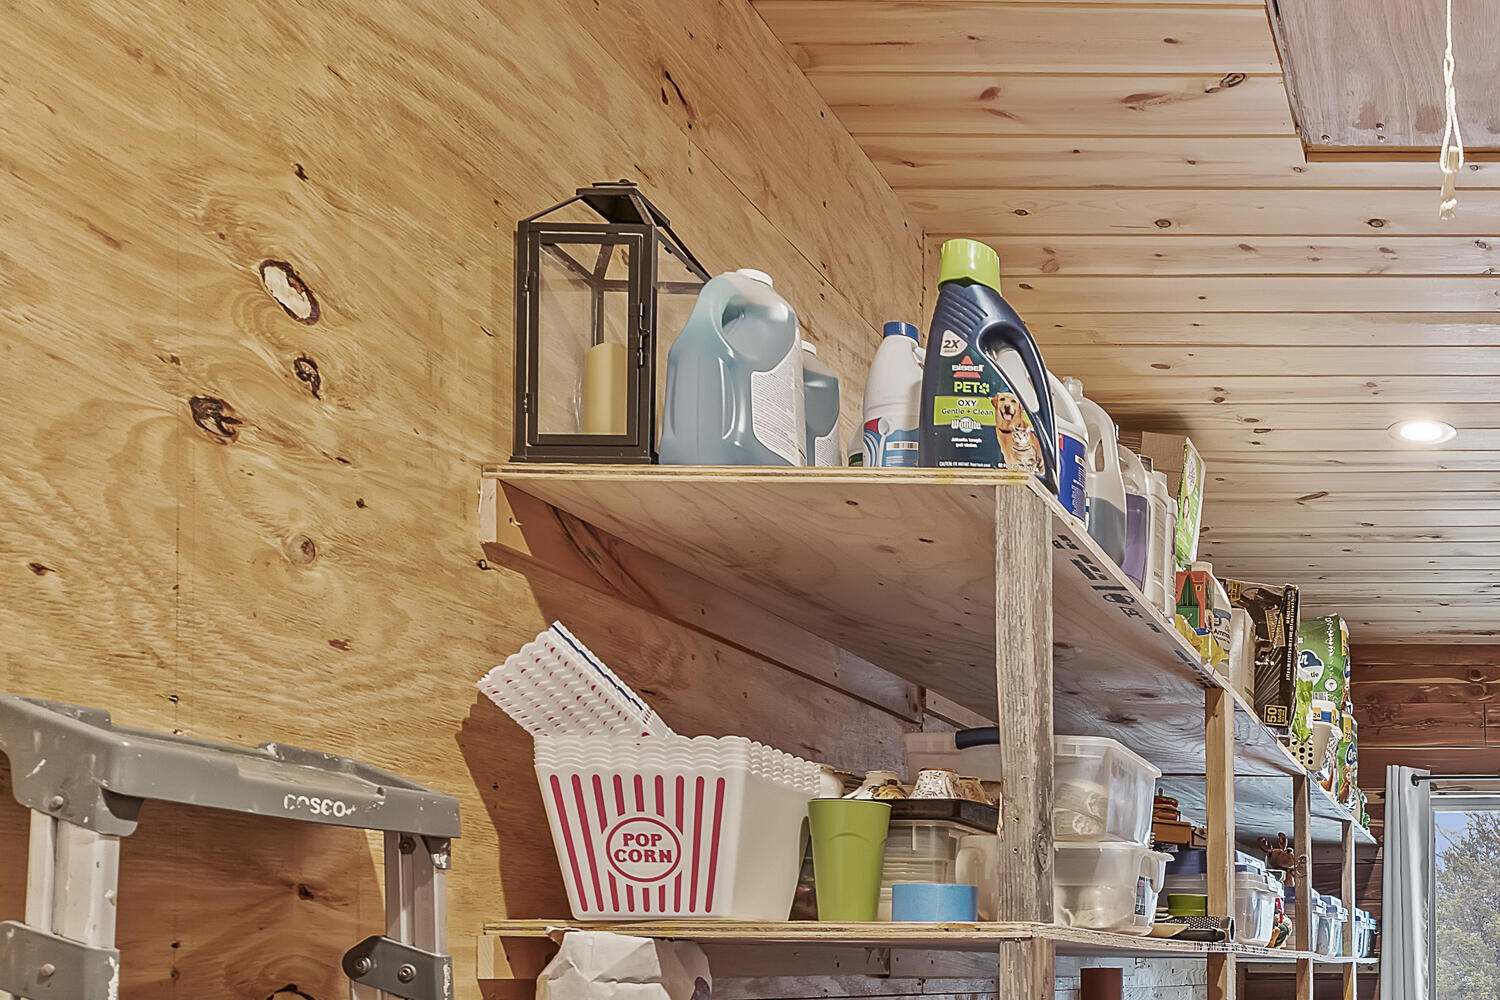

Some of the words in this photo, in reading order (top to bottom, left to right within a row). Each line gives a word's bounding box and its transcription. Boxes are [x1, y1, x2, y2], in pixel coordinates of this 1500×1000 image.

[943, 340, 960, 348] 2X
[1267, 707, 1278, 723] 50
[623, 833, 663, 847] POP
[614, 848, 672, 863] CORN
